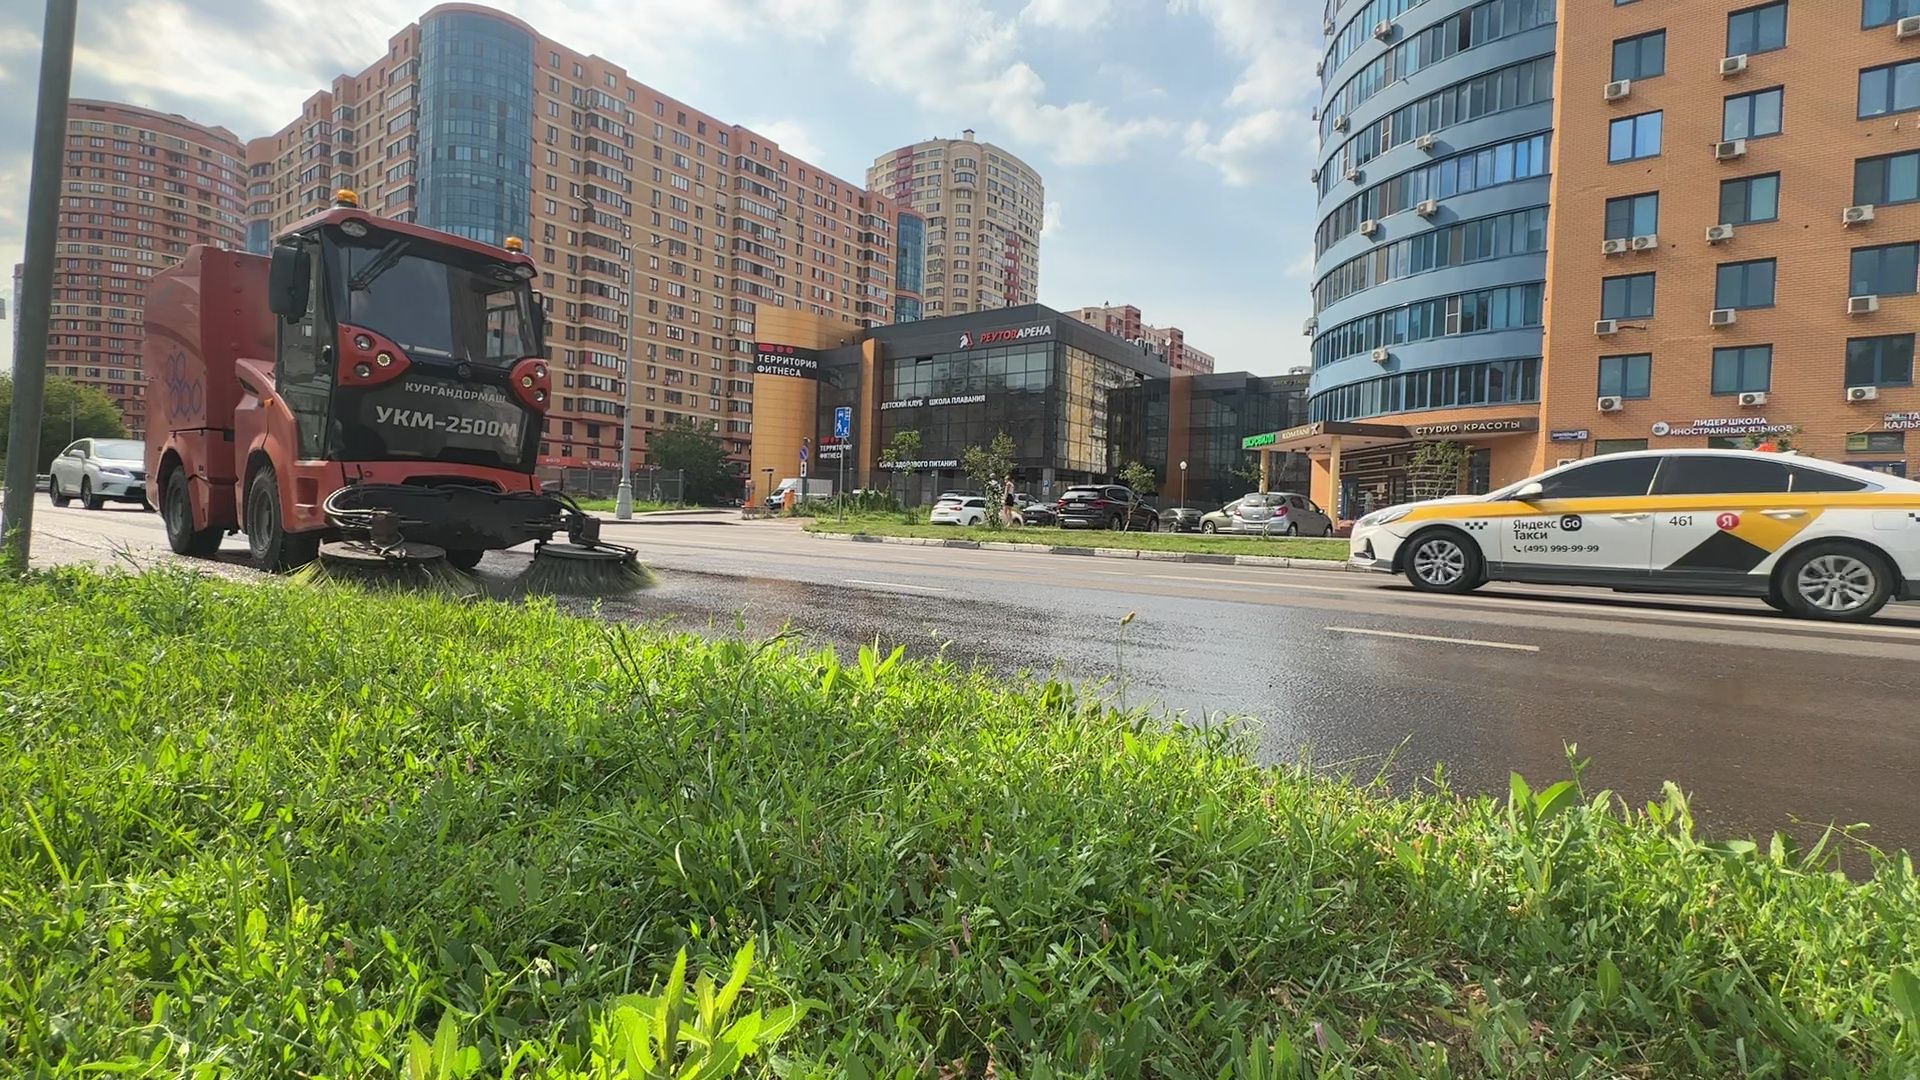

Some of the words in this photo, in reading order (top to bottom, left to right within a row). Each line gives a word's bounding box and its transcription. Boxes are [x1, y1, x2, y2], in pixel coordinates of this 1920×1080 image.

[980, 325, 1051, 343] РЕУТОВАРЕНА
[757, 354, 817, 369] ТЕРРИТОРИЯ
[757, 365, 801, 377] ФИТНЕСА
[405, 382, 506, 403] КУРГАНДОРМАШ
[881, 400, 907, 410] ДЕТСКИЙ
[907, 400, 923, 408] КЛУБ
[929, 398, 951, 406] ШКОЛА
[951, 395, 986, 404] ПЛАВАНИЯ
[376, 405, 518, 437] УКМ-2500М
[1463, 421, 1520, 431] КРАСОТЫ
[1693, 419, 1727, 427] ЛИДЕР
[1728, 417, 1768, 425] ШКОЛА
[1670, 426, 1746, 435] ИНОСТРАННЫХ
[929, 460, 957, 468] ПИТАНИЯ
[1513, 519, 1557, 530] Яндекс
[1561, 517, 1580, 528] Go
[1669, 516, 1693, 526] 461
[1721, 514, 1733, 527] Я
[1513, 530, 1548, 540] Такси
[1523, 545, 1548, 553] (495)
